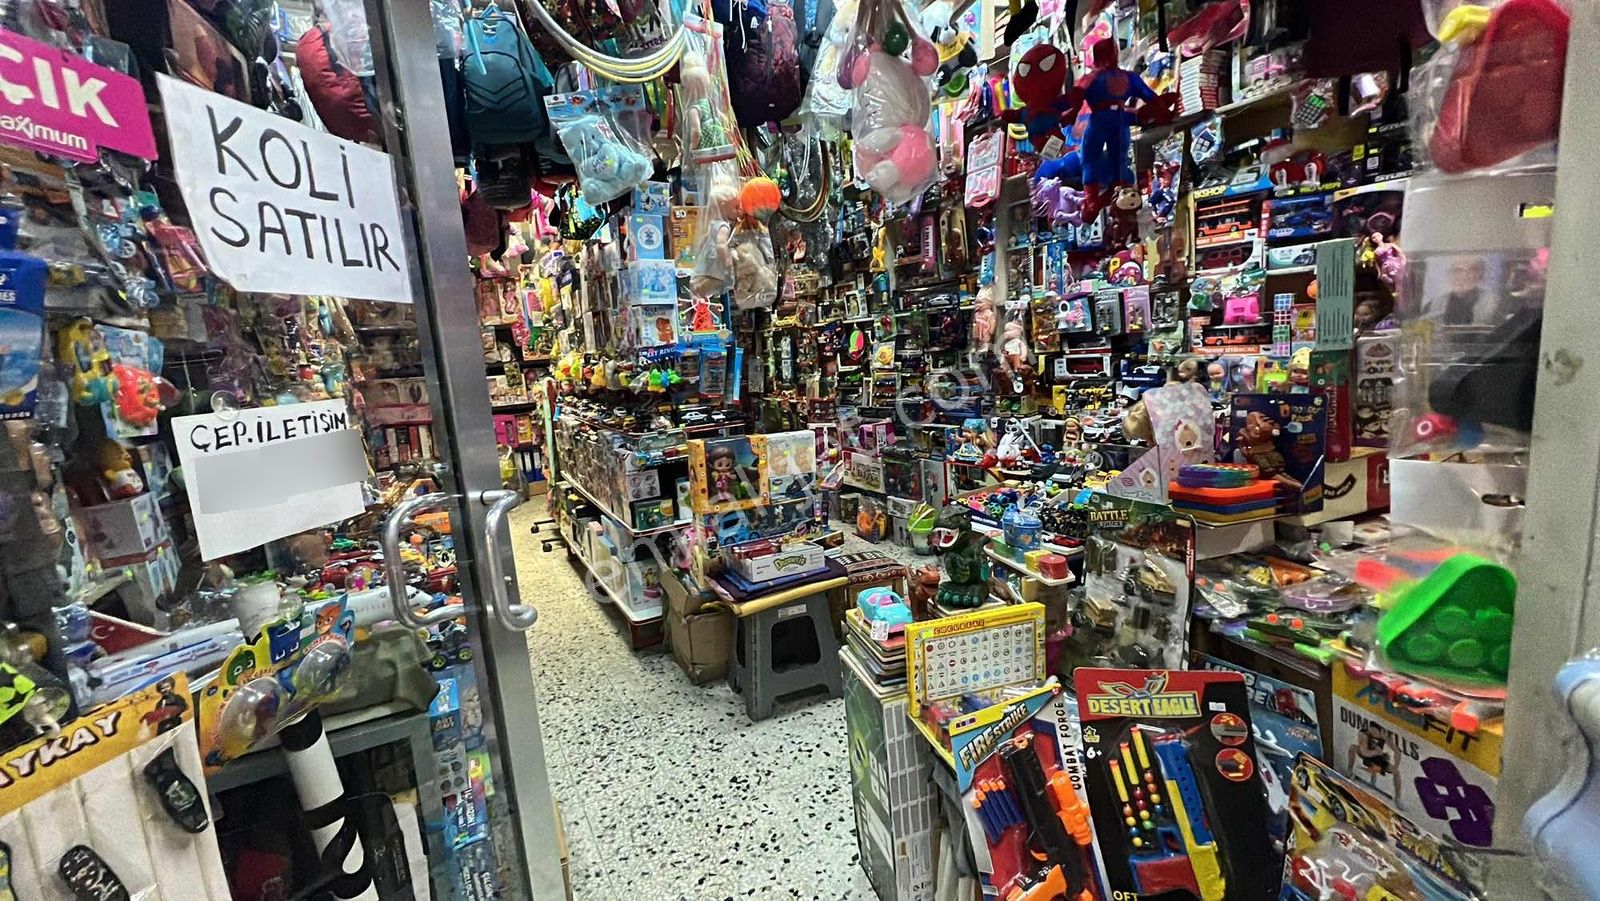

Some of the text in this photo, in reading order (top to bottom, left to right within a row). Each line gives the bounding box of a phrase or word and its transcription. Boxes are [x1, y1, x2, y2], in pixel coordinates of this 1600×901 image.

[210, 187, 400, 272] SATILIR
[958, 702, 1028, 772] FIRESTRIKE
[1088, 698, 1197, 715] DESERT EAGLE
[1054, 702, 1082, 790] COMBAT FORCE
[1086, 746, 1102, 759] 6+
